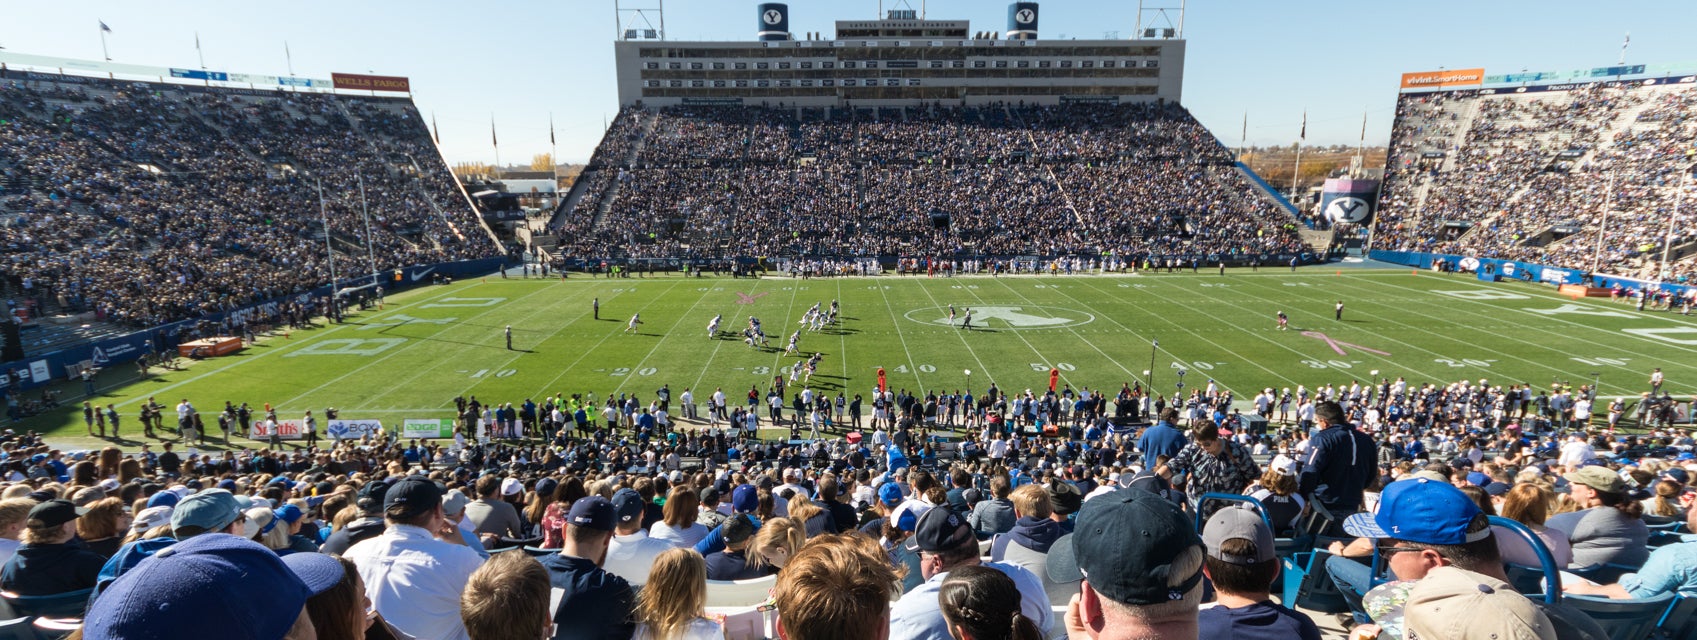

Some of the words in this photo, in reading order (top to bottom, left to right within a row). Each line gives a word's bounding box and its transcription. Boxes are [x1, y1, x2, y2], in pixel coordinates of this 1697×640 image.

[334, 77, 370, 87] WELLS
[373, 78, 407, 88] FARGO
[609, 367, 657, 376] 20
[893, 364, 937, 373] 40
[1029, 362, 1076, 372] 50
